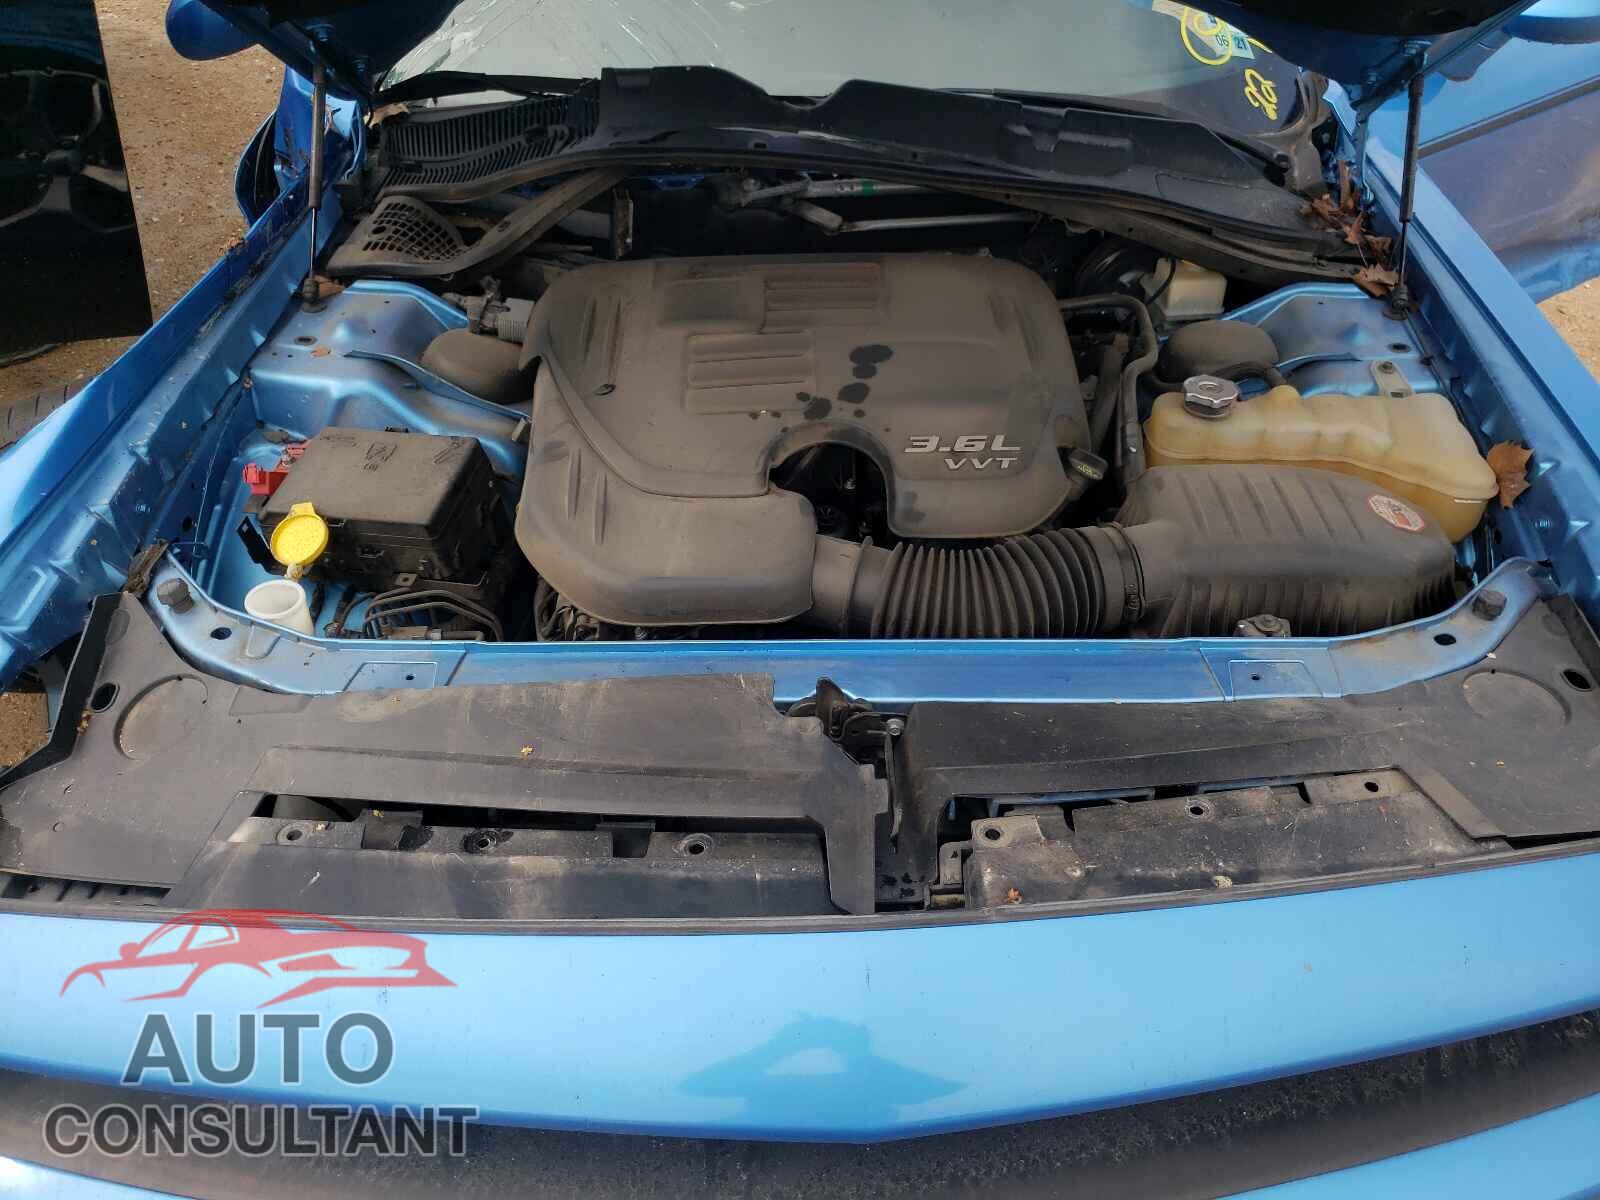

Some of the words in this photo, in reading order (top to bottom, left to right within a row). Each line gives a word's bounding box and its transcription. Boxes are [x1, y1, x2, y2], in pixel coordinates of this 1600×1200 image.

[1233, 35, 1248, 50] 21
[904, 435, 1021, 453] 3.6L
[943, 457, 1018, 470] VVT
